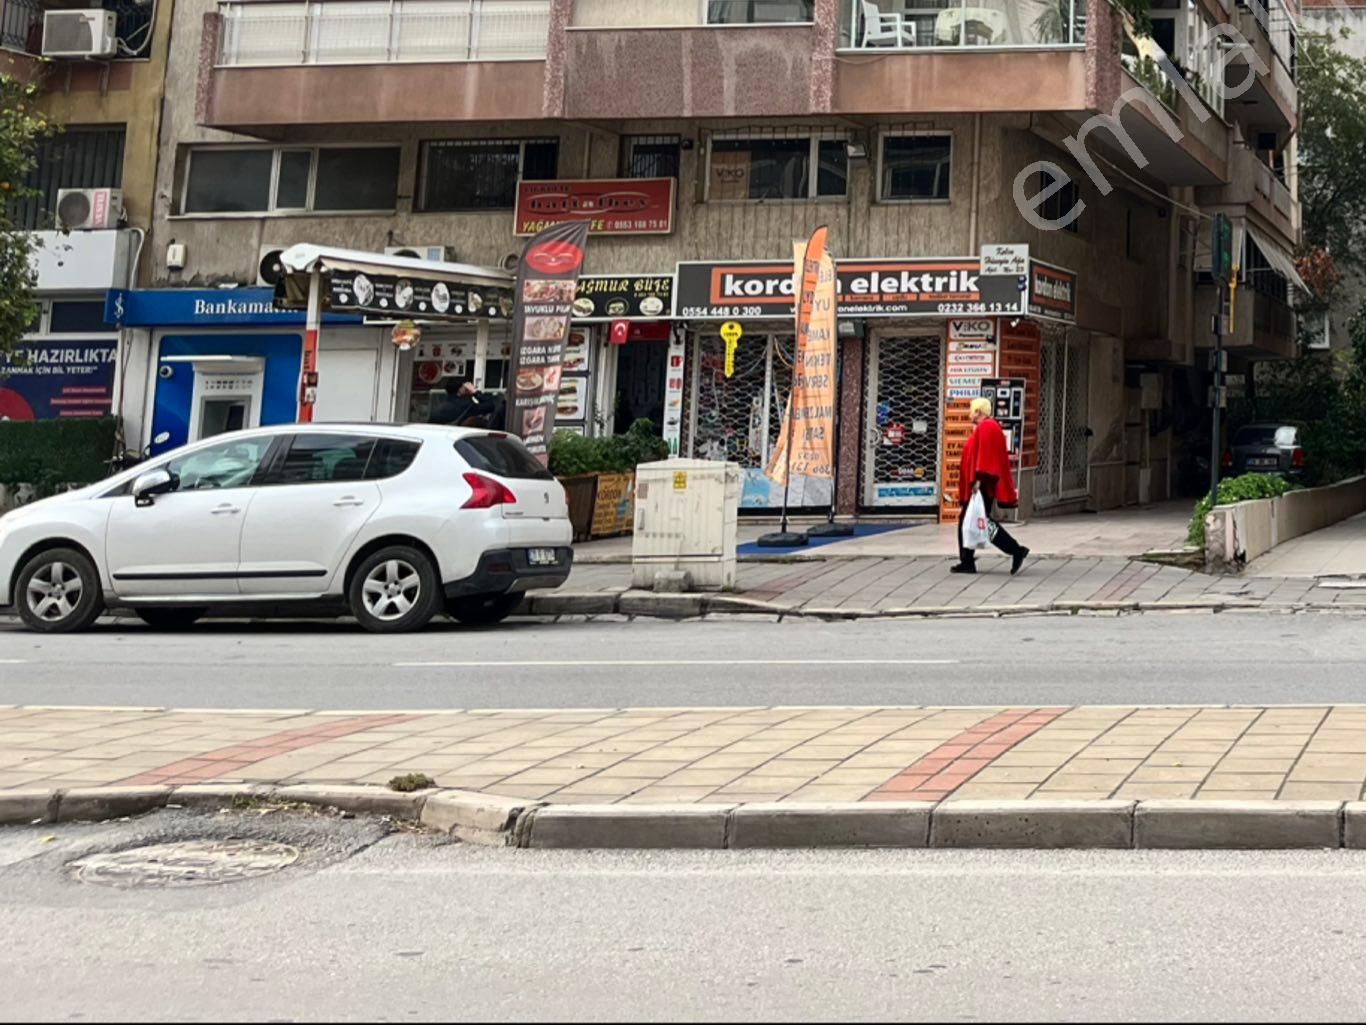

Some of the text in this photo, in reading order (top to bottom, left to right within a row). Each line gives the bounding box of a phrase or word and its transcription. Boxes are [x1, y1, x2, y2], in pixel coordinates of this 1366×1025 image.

[851, 270, 979, 293] elektrik
[195, 298, 299, 315] Bankama
[732, 306, 740, 316] 0
[742, 306, 762, 316] 300
[938, 303, 963, 313] 0232
[989, 302, 1002, 312] 13
[1005, 302, 1018, 312] 14
